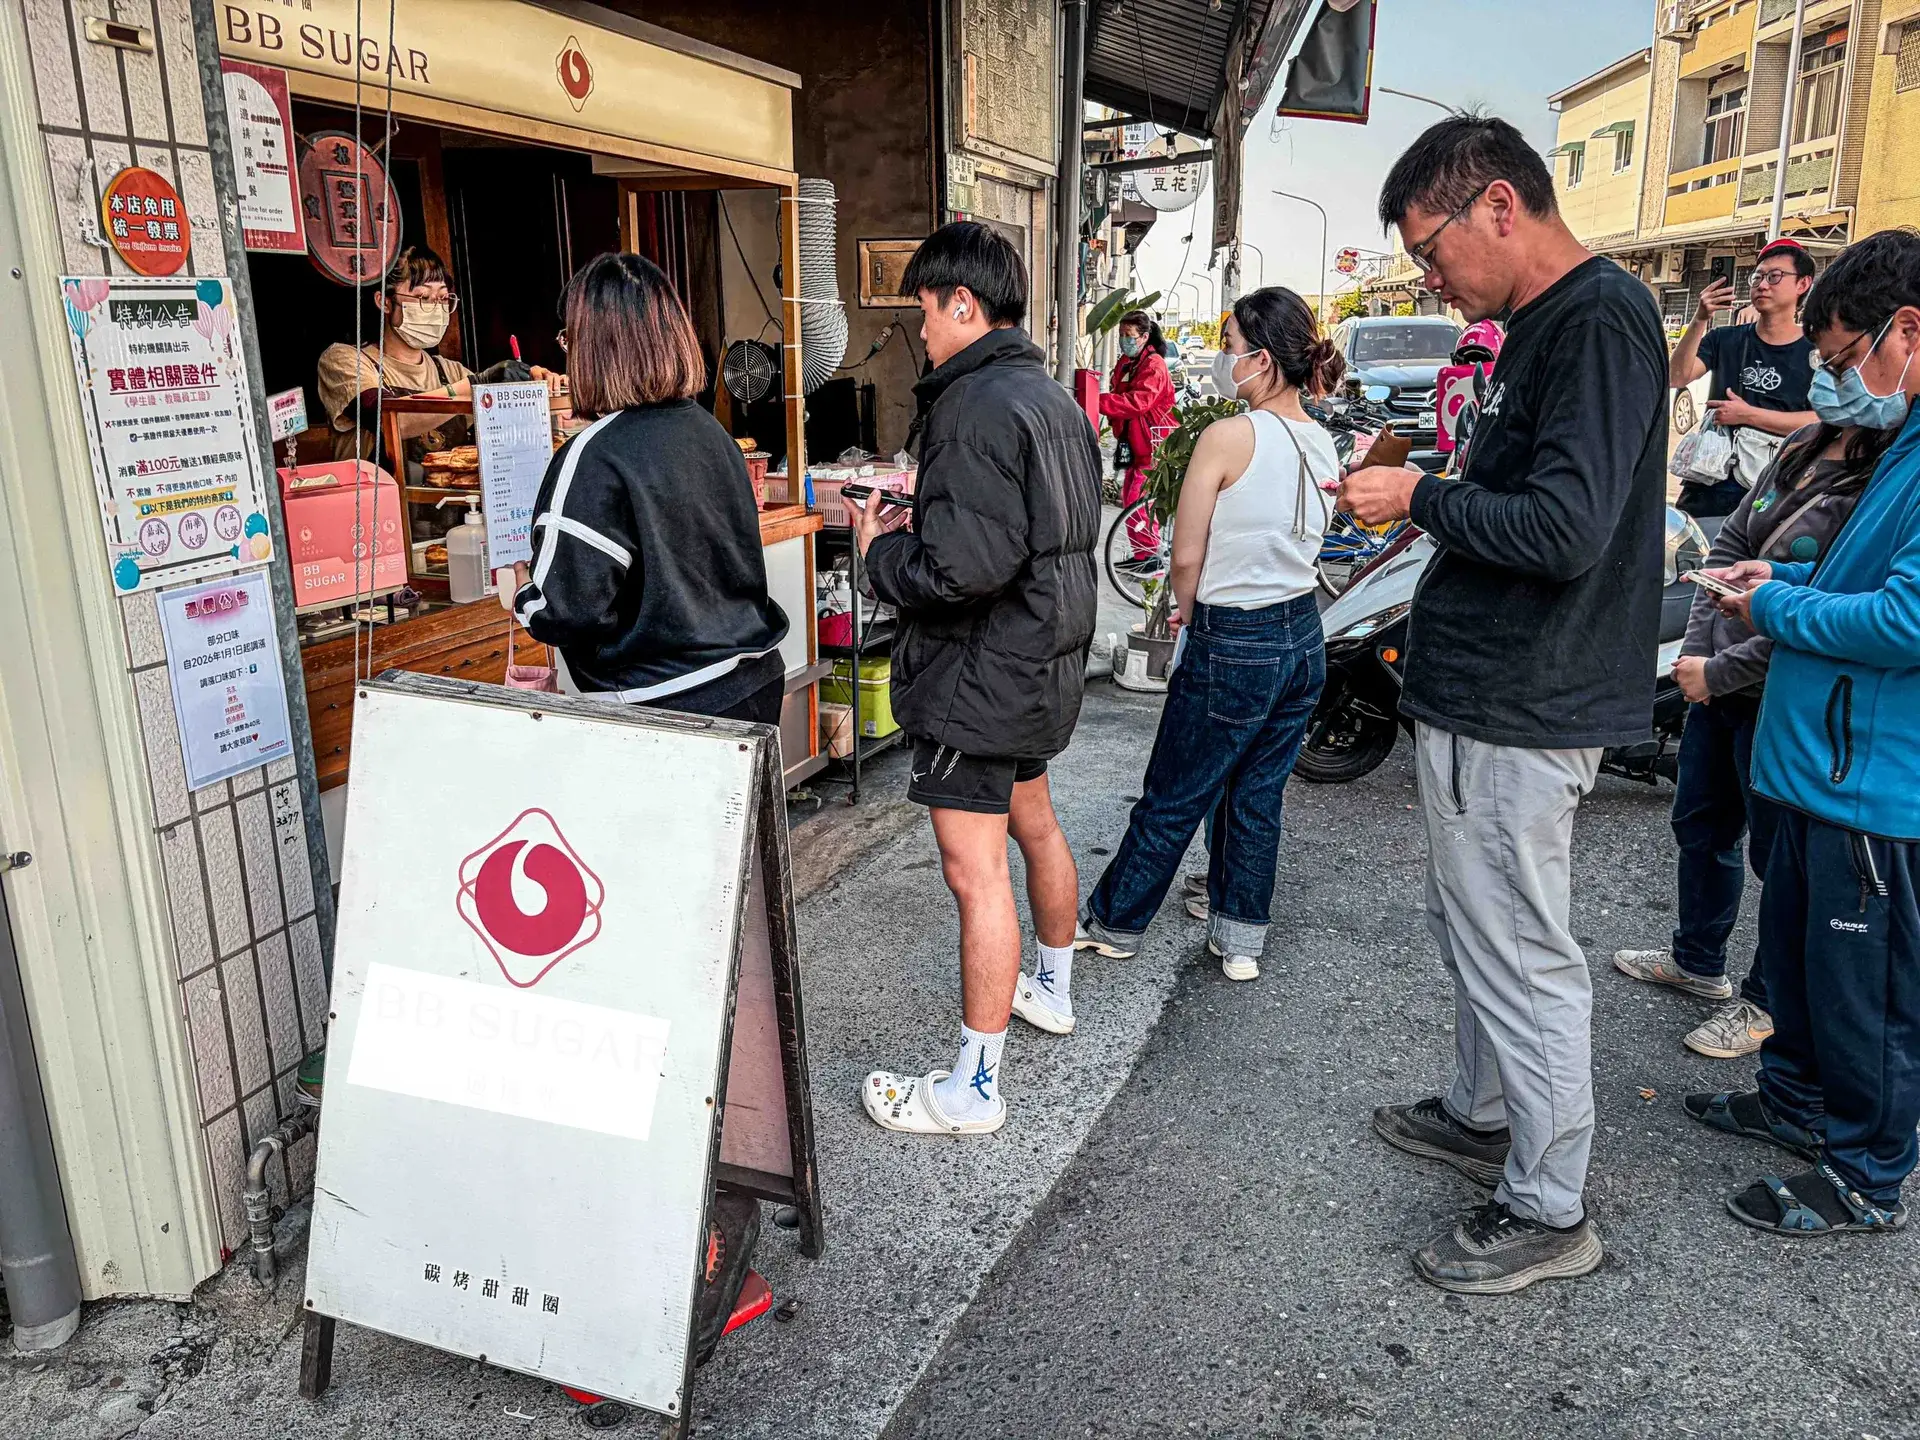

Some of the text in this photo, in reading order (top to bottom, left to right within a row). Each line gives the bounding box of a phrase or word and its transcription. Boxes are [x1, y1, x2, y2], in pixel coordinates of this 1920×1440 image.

[223, 5, 430, 84] BB SUGAR
[1151, 176, 1187, 192] 豆花
[109, 193, 177, 218] 本店免用
[247, 205, 258, 213] line
[113, 218, 180, 240] 統一發票
[131, 241, 157, 252] Uniform
[116, 303, 192, 330] 特約公告
[128, 341, 191, 355] 特約機關請出示
[107, 362, 218, 391] 實體相關證件
[497, 389, 543, 401] BB SUGAR
[149, 492, 226, 514] 以下是我們的特約商家
[220, 511, 236, 522] 中正
[147, 523, 165, 537] 嘉義
[223, 525, 239, 538] 大學
[150, 539, 167, 553] 大學
[188, 533, 204, 546] 大學
[303, 564, 320, 576] BB
[305, 572, 345, 589] SUGAR
[207, 630, 239, 646] 部分口味
[183, 638, 266, 670] 自2026年1月1日起調漲
[1822, 1165, 1846, 1187] LOTTO
[424, 1262, 560, 1315] 碳烤甜甜圈
